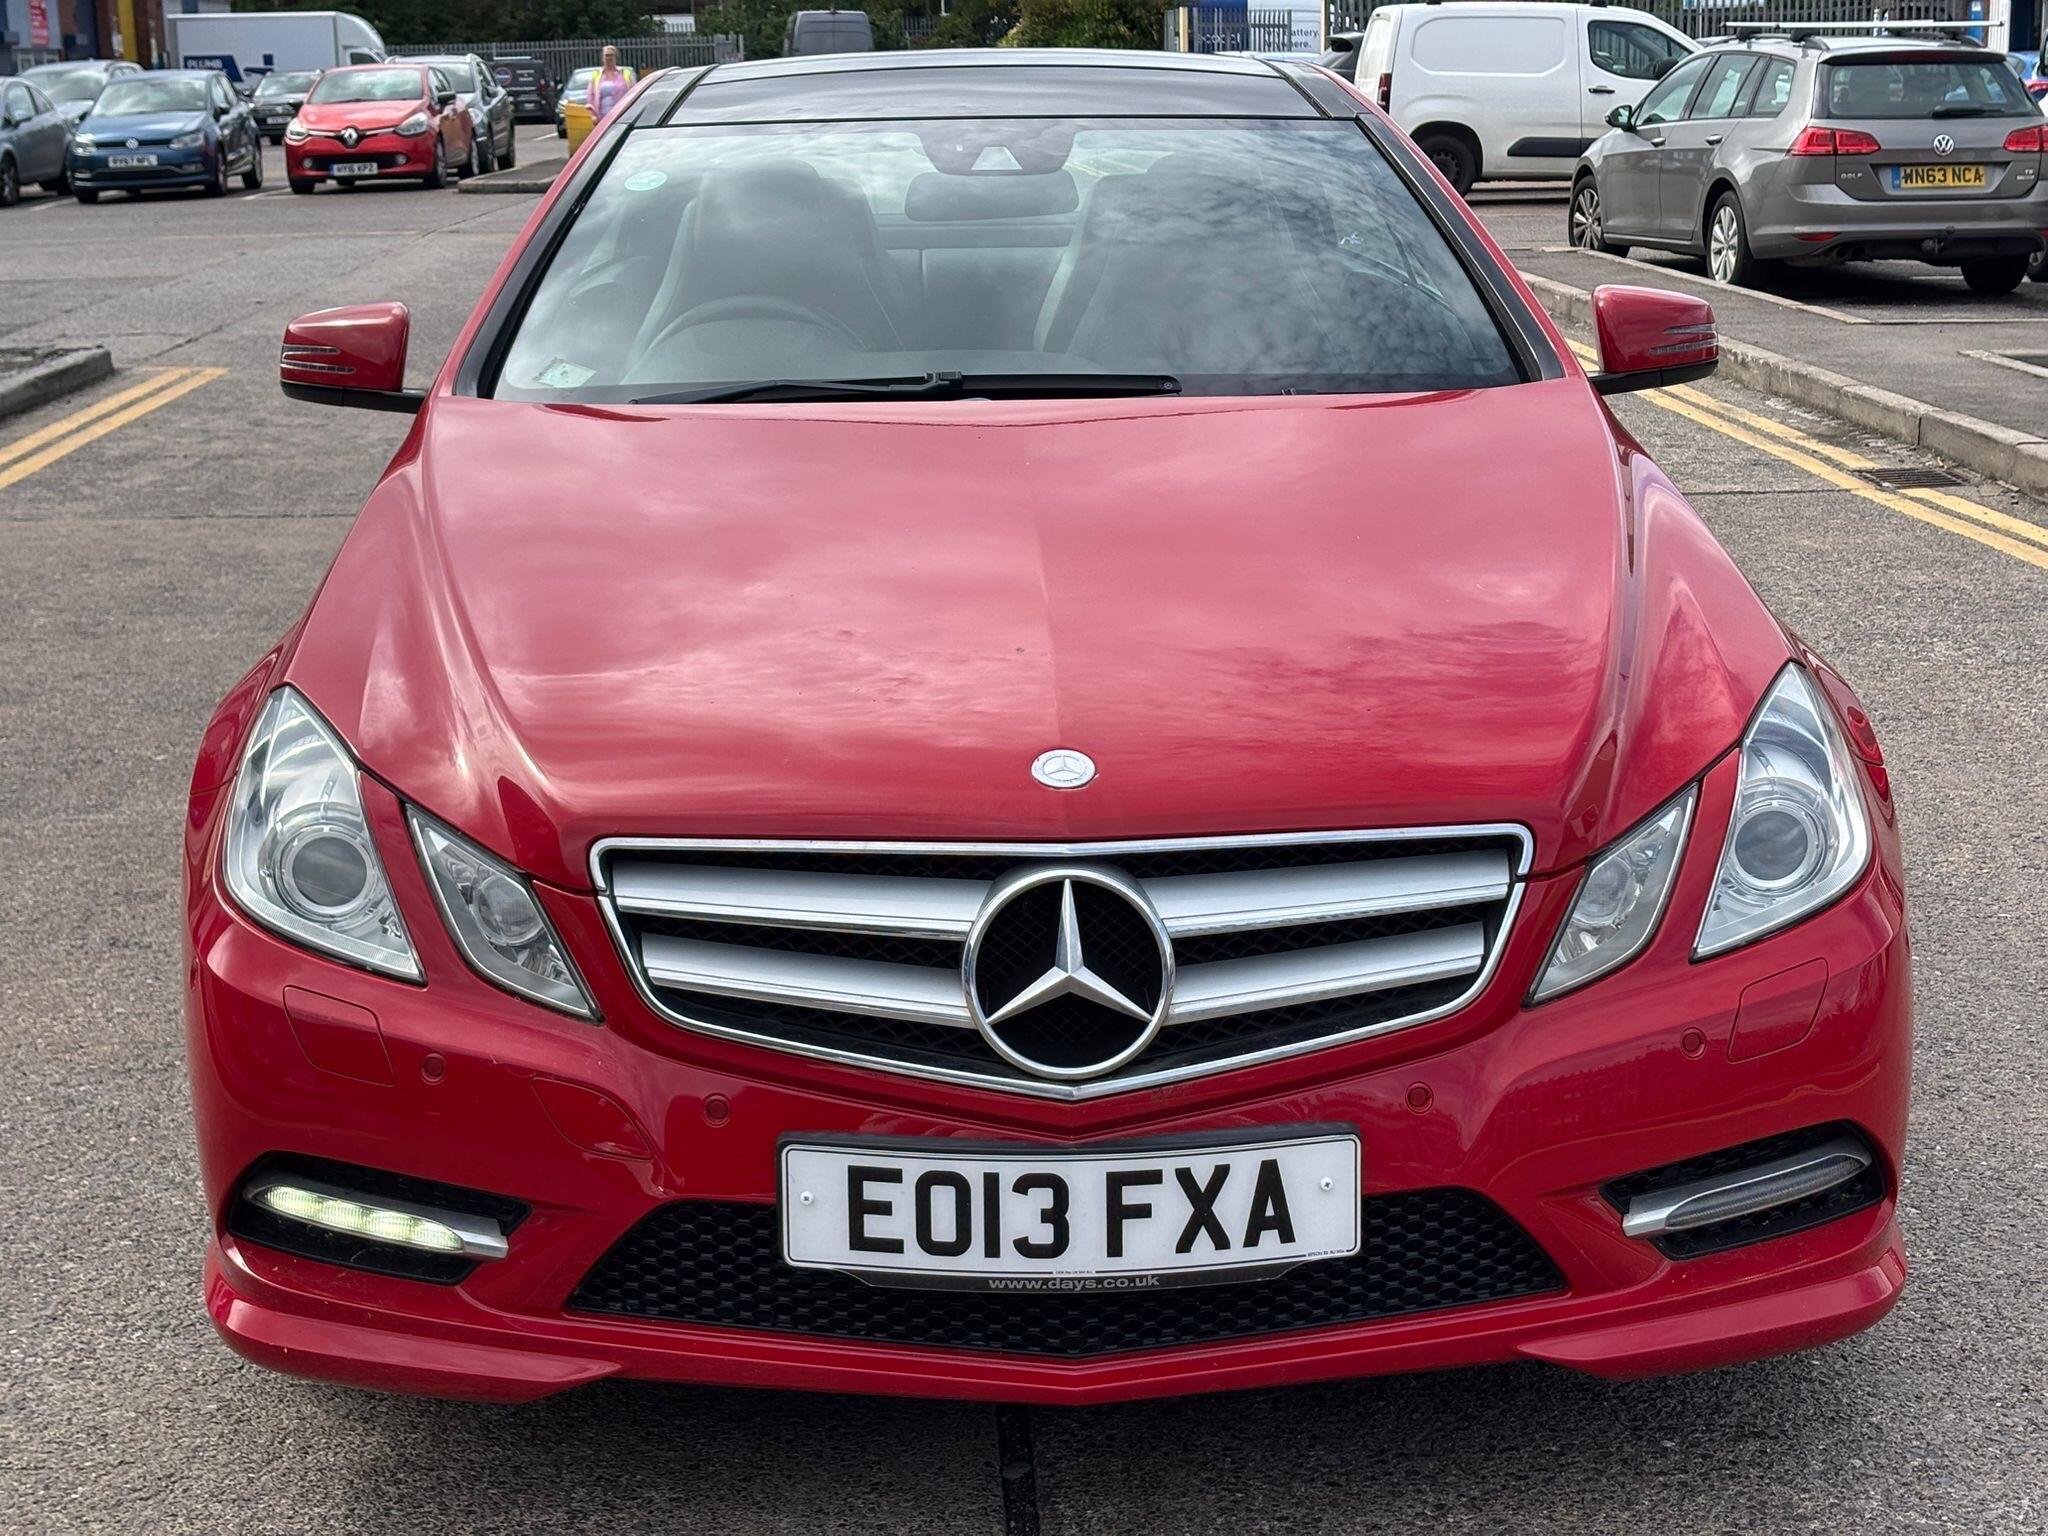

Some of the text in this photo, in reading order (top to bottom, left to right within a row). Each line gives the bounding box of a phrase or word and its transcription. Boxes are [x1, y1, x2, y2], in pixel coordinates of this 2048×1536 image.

[1903, 165, 1983, 184] WN63 NCA
[847, 1158, 1297, 1259] EO13 FXA
[988, 1275, 1160, 1291] www.days.co.uk
